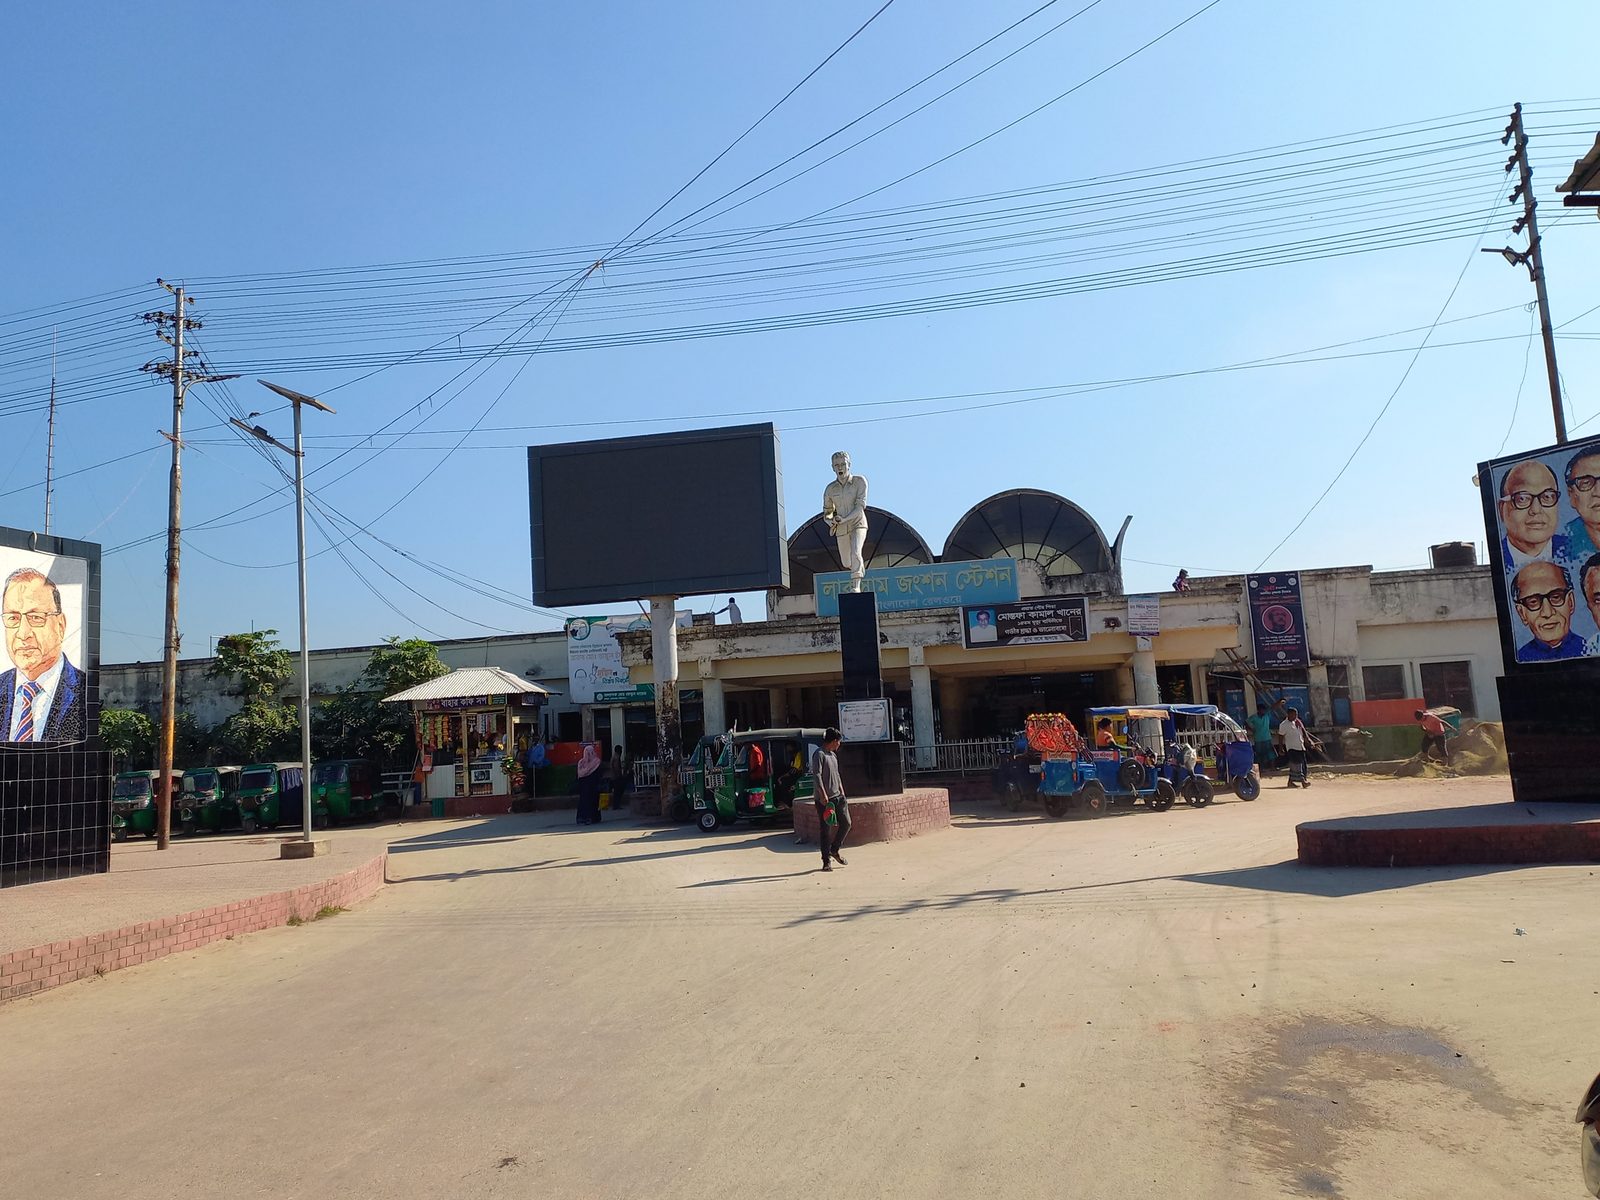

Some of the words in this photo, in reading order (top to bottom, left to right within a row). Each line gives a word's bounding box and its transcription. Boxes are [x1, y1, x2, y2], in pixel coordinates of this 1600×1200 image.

[896, 571, 949, 594] জংশন
[956, 562, 1012, 590] স্টেশন
[878, 599, 918, 610] াংলাদেশ
[1027, 609, 1054, 620] কামাল
[1056, 607, 1082, 617] খানের
